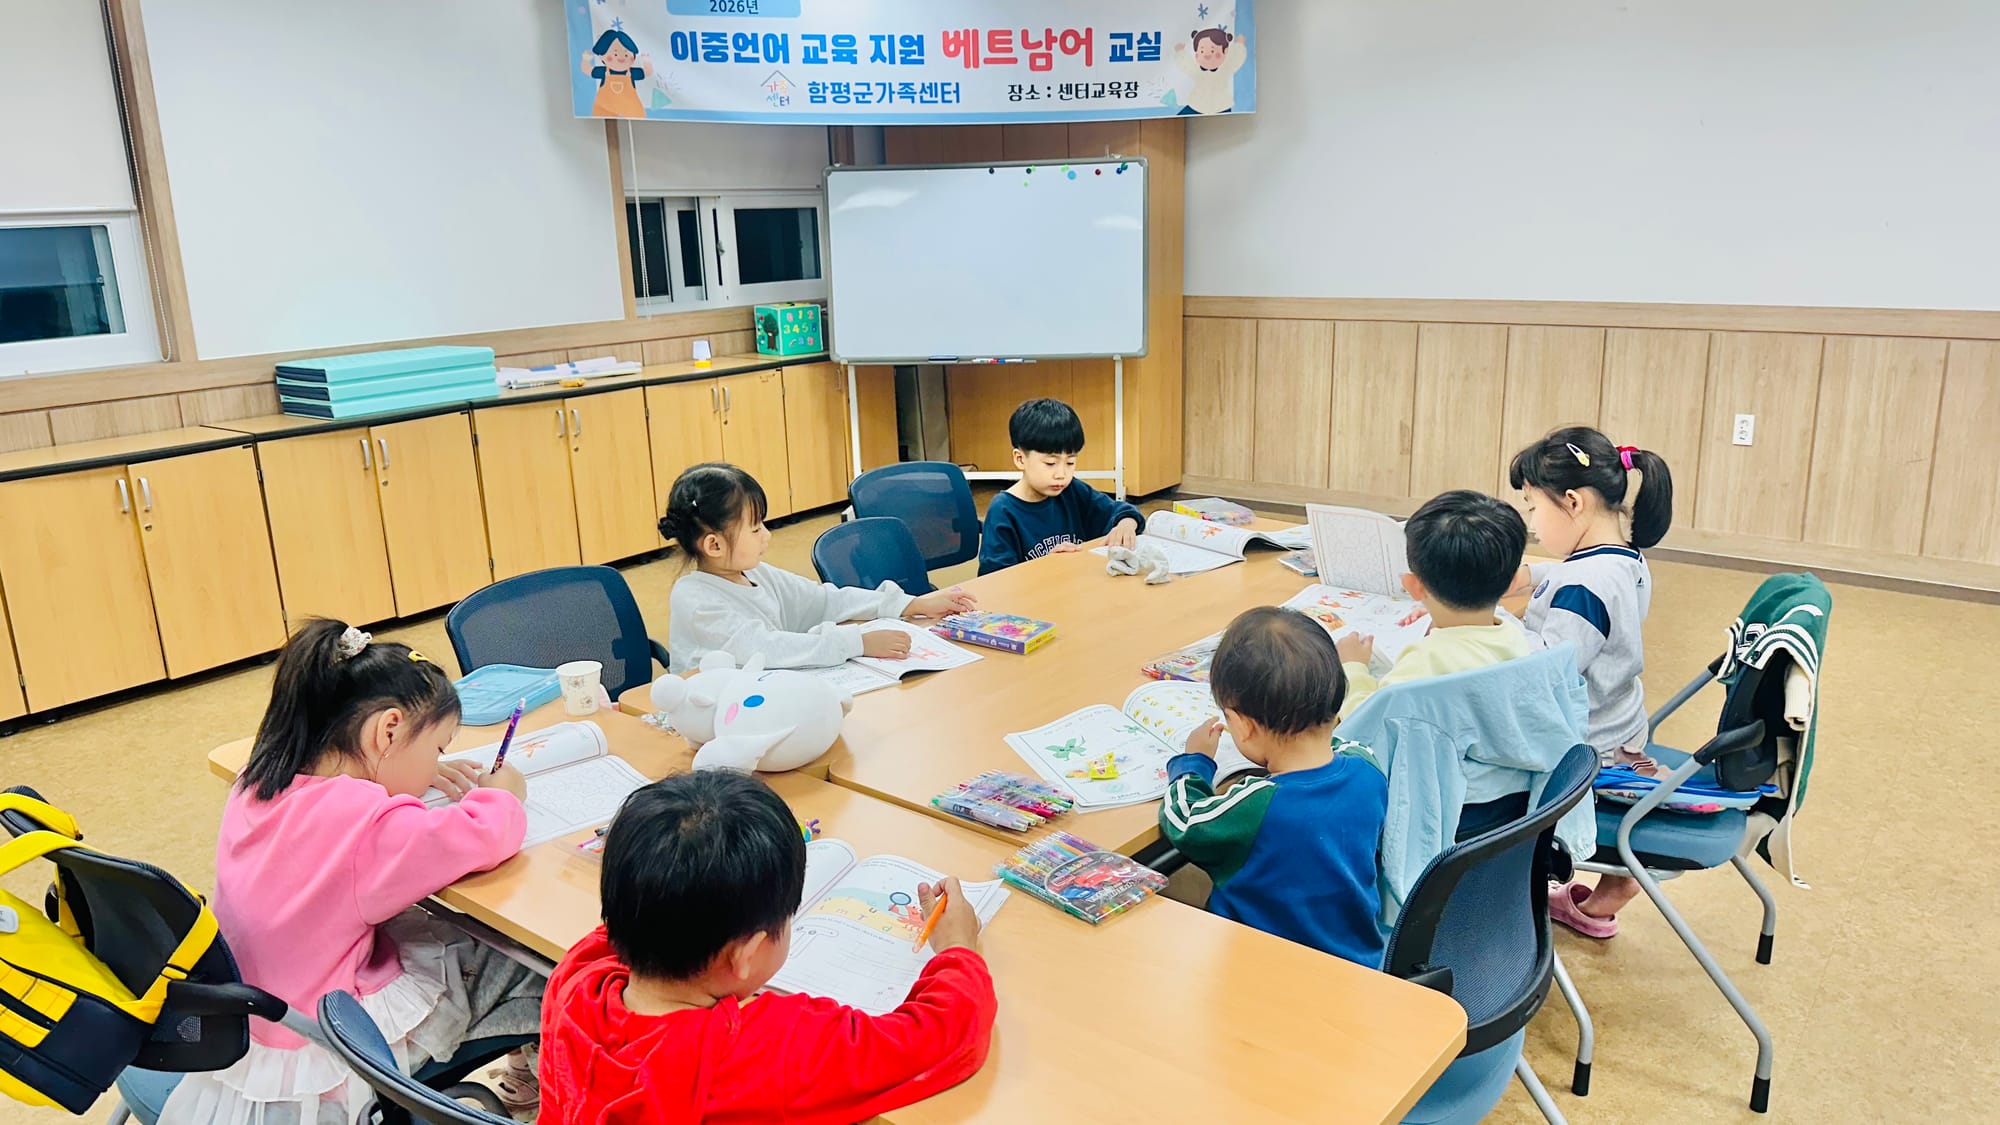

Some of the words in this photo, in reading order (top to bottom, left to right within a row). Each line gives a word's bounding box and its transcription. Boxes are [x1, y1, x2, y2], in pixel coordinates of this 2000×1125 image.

[709, 0, 759, 14] 2026년
[670, 31, 790, 64] 이중언어
[801, 34, 858, 65] 교육
[869, 33, 925, 65] 지원
[942, 27, 1093, 72] 베트남어
[1108, 31, 1161, 63] 교실
[767, 92, 790, 107] 센터
[808, 81, 961, 105] 함평군가족센터
[1007, 83, 1041, 102] 장소
[1057, 80, 1140, 101] 센터교육장
[784, 324, 791, 334] 3
[792, 323, 800, 334] 4
[802, 322, 809, 333] 5
